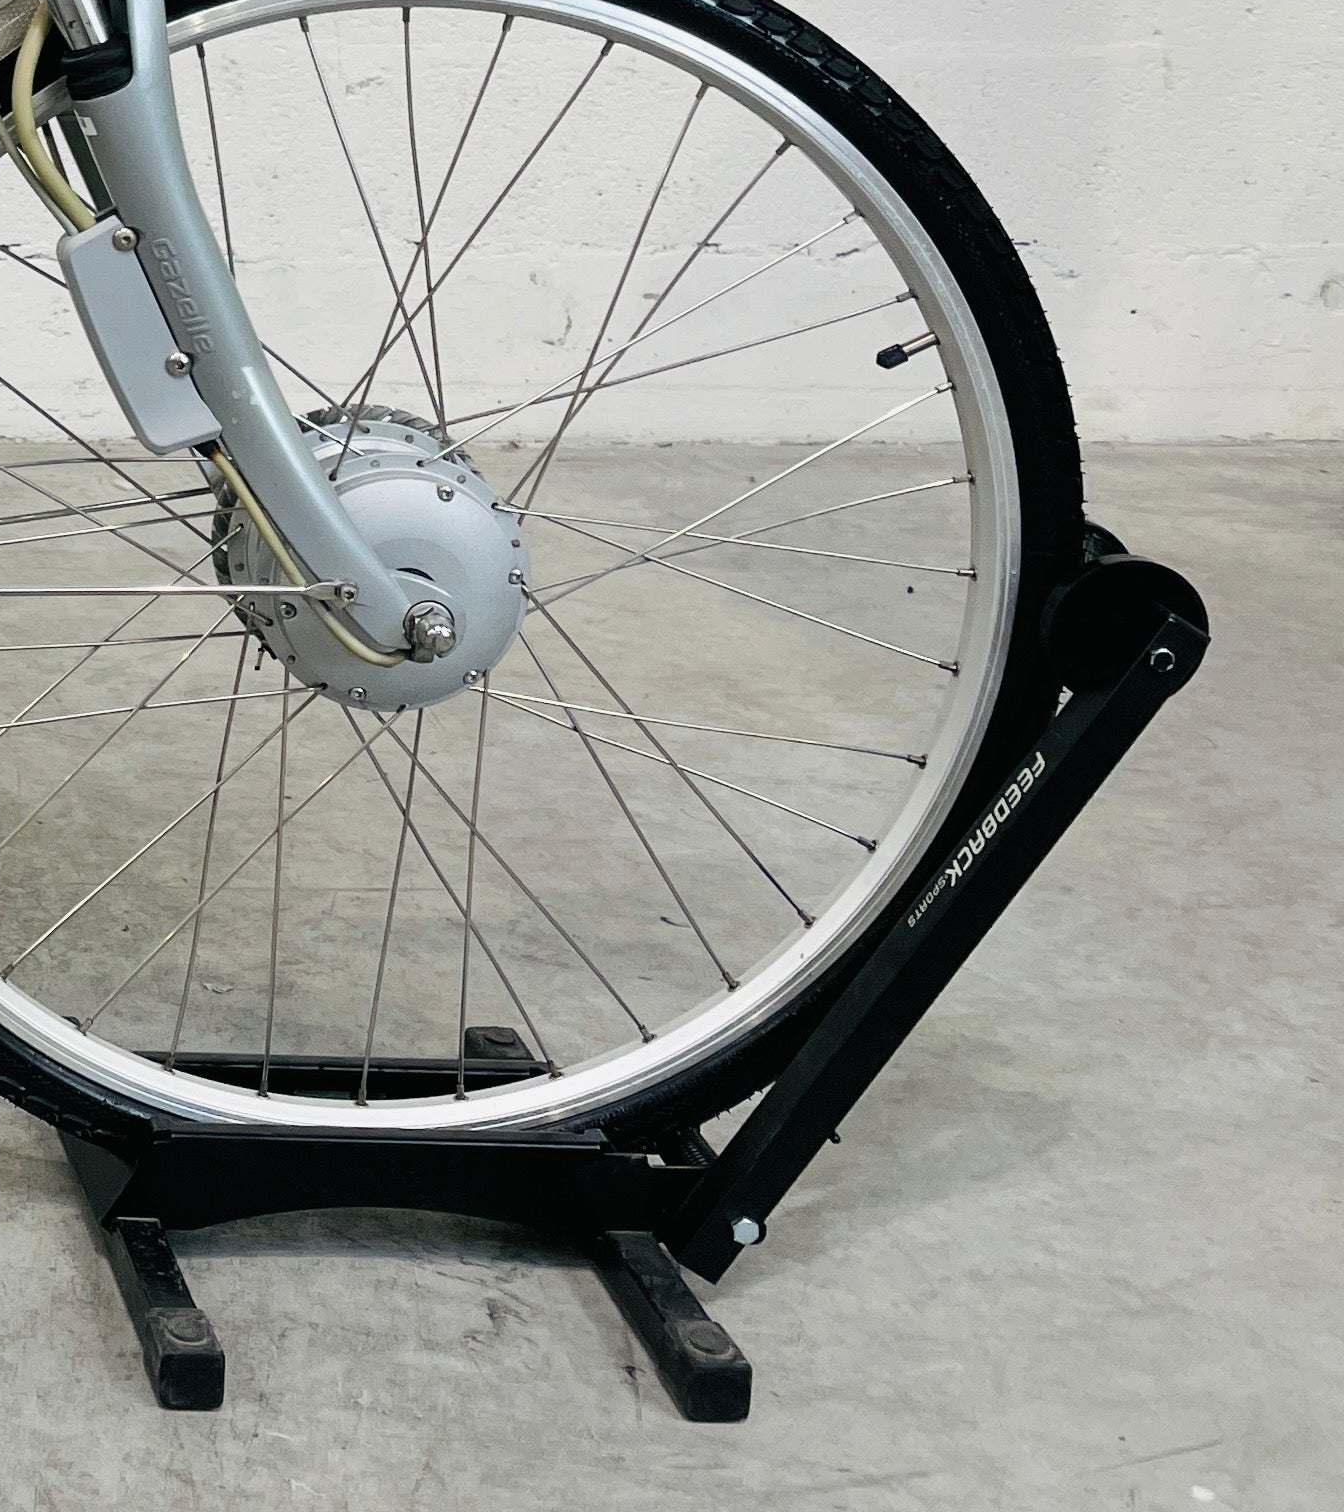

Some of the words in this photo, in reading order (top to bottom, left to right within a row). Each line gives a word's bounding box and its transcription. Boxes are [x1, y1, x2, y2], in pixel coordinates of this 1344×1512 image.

[152, 237, 214, 354] Gazelle
[945, 751, 1045, 887] FEEDBACK
[907, 875, 947, 927] SPORTS
